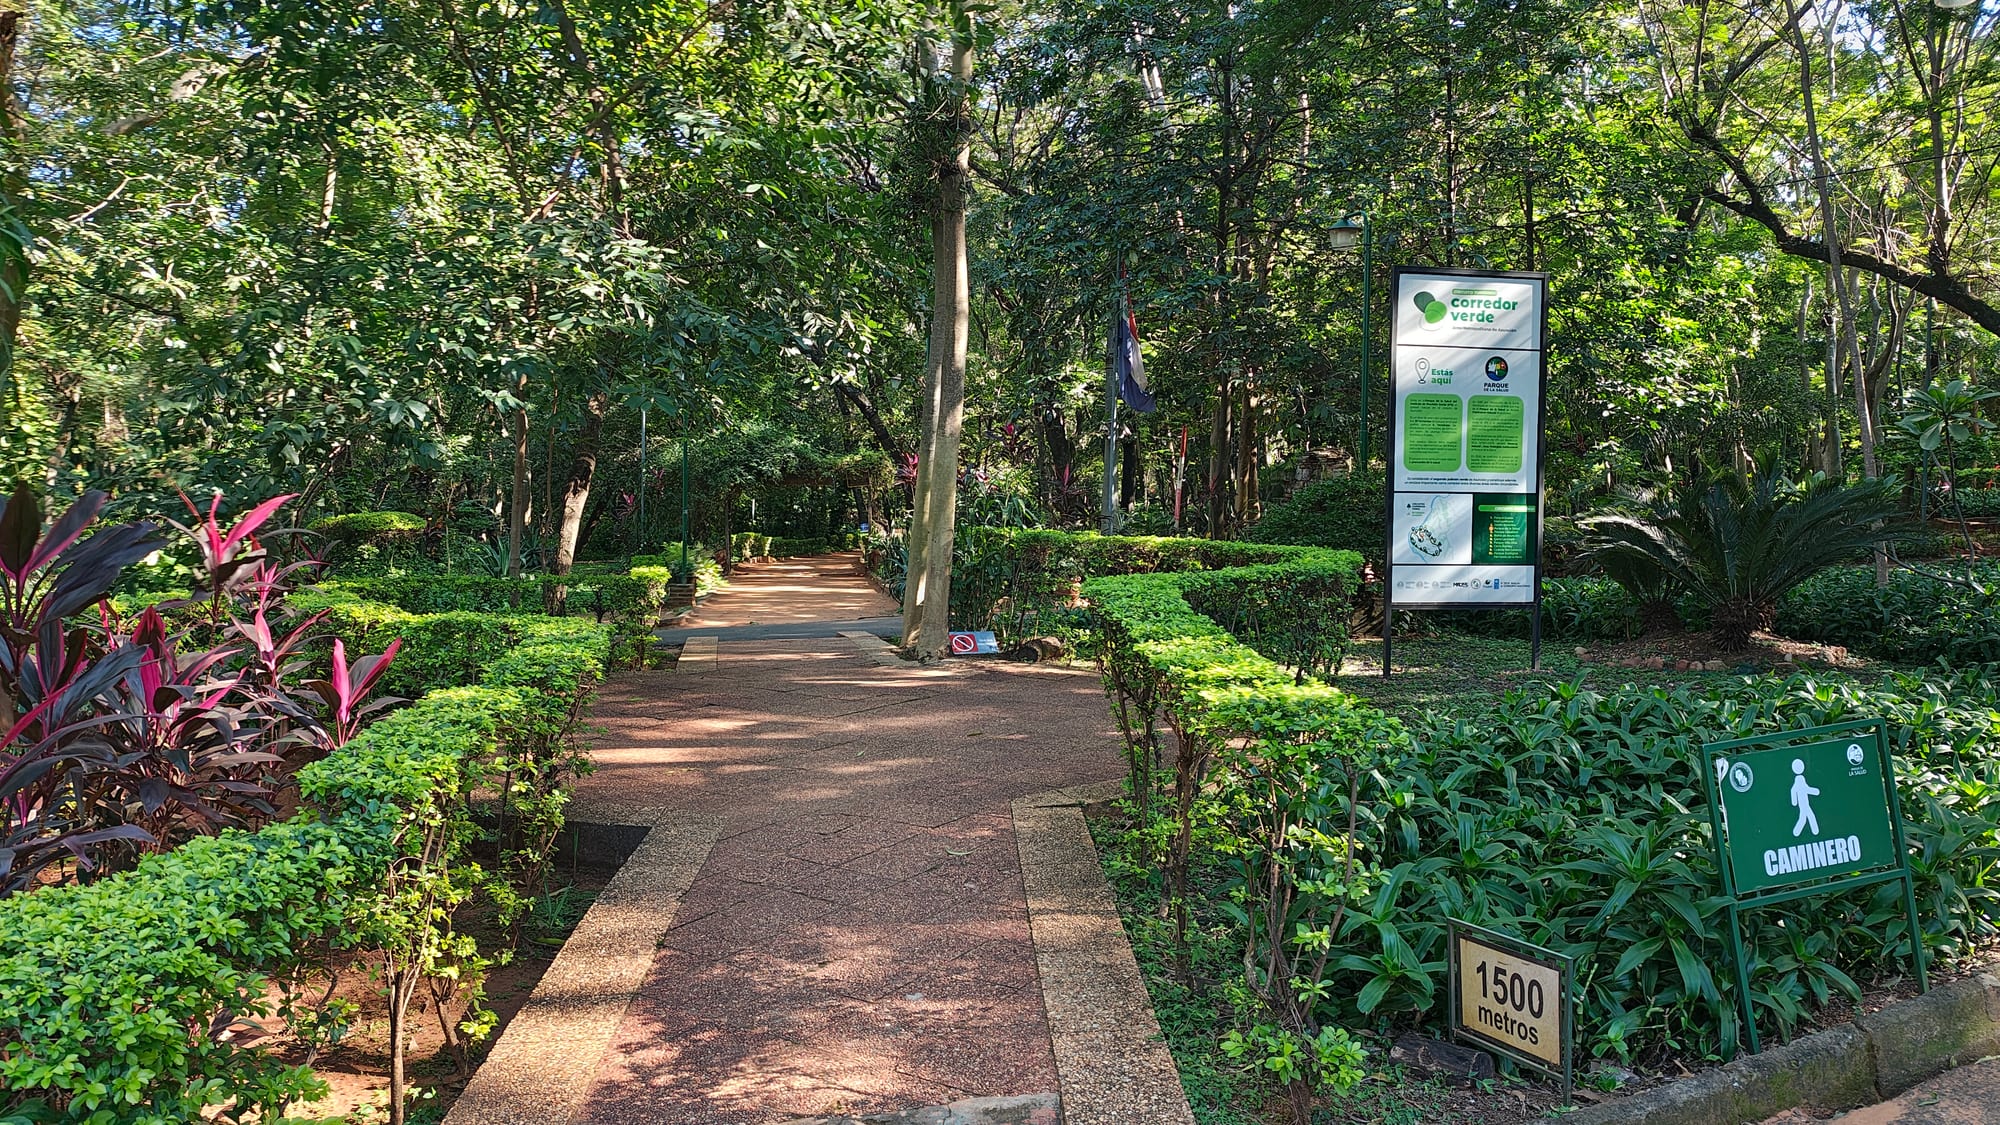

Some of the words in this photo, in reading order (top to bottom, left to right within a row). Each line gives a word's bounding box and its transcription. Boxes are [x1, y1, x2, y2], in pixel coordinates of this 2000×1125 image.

[1451, 297, 1518, 310] corredor
[1451, 310, 1494, 323] verde
[1431, 368, 1453, 376] Estás
[1431, 376, 1452, 385] aquí
[1763, 835, 1861, 877] CAMINERO
[1476, 960, 1544, 1019] 1500
[1478, 1005, 1539, 1046] metros
